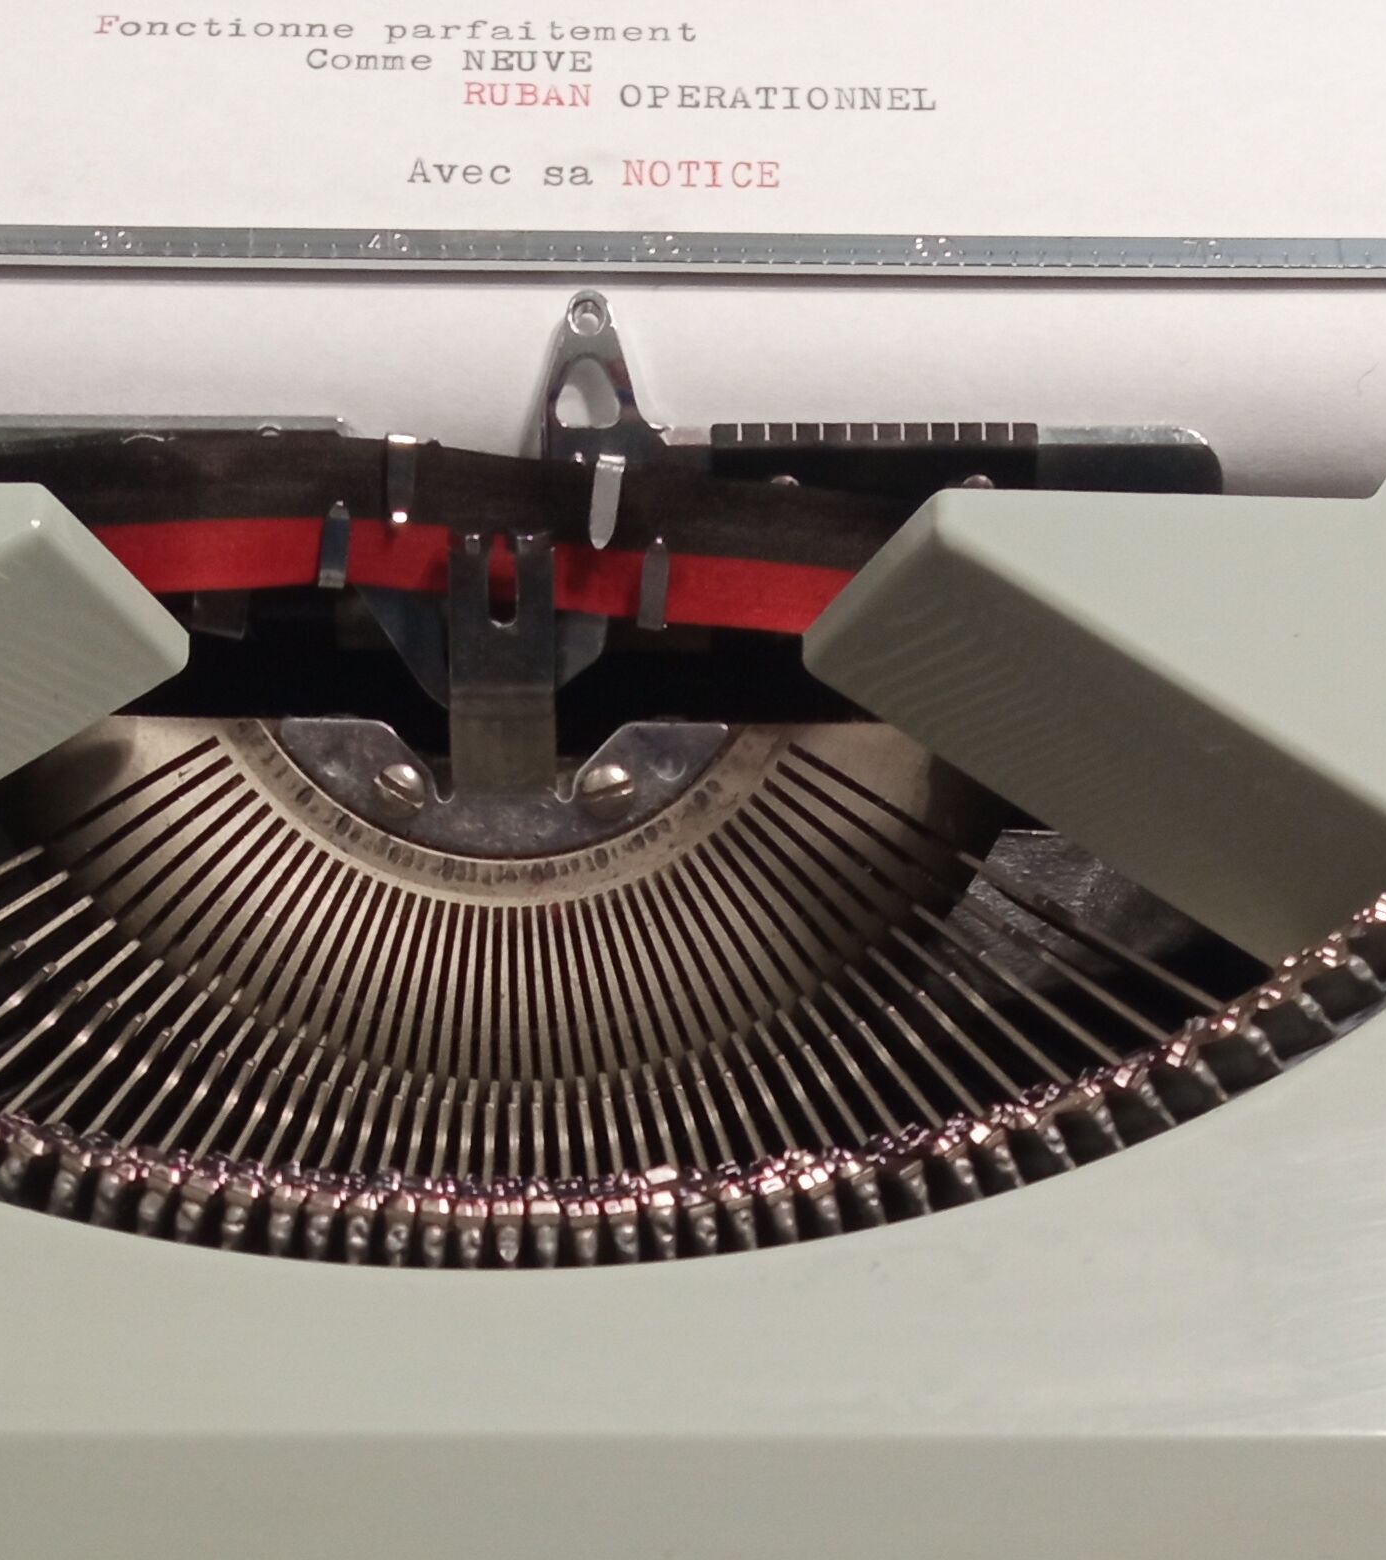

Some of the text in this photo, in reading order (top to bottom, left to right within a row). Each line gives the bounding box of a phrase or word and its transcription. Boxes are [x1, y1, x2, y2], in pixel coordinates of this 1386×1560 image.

[93, 14, 698, 44] Fonctionne parfaitement
[306, 48, 593, 73] Comme NEUVE
[464, 81, 938, 112] RUBAN OPERATIONNEL
[407, 158, 781, 188] Avec sa NOTICE
